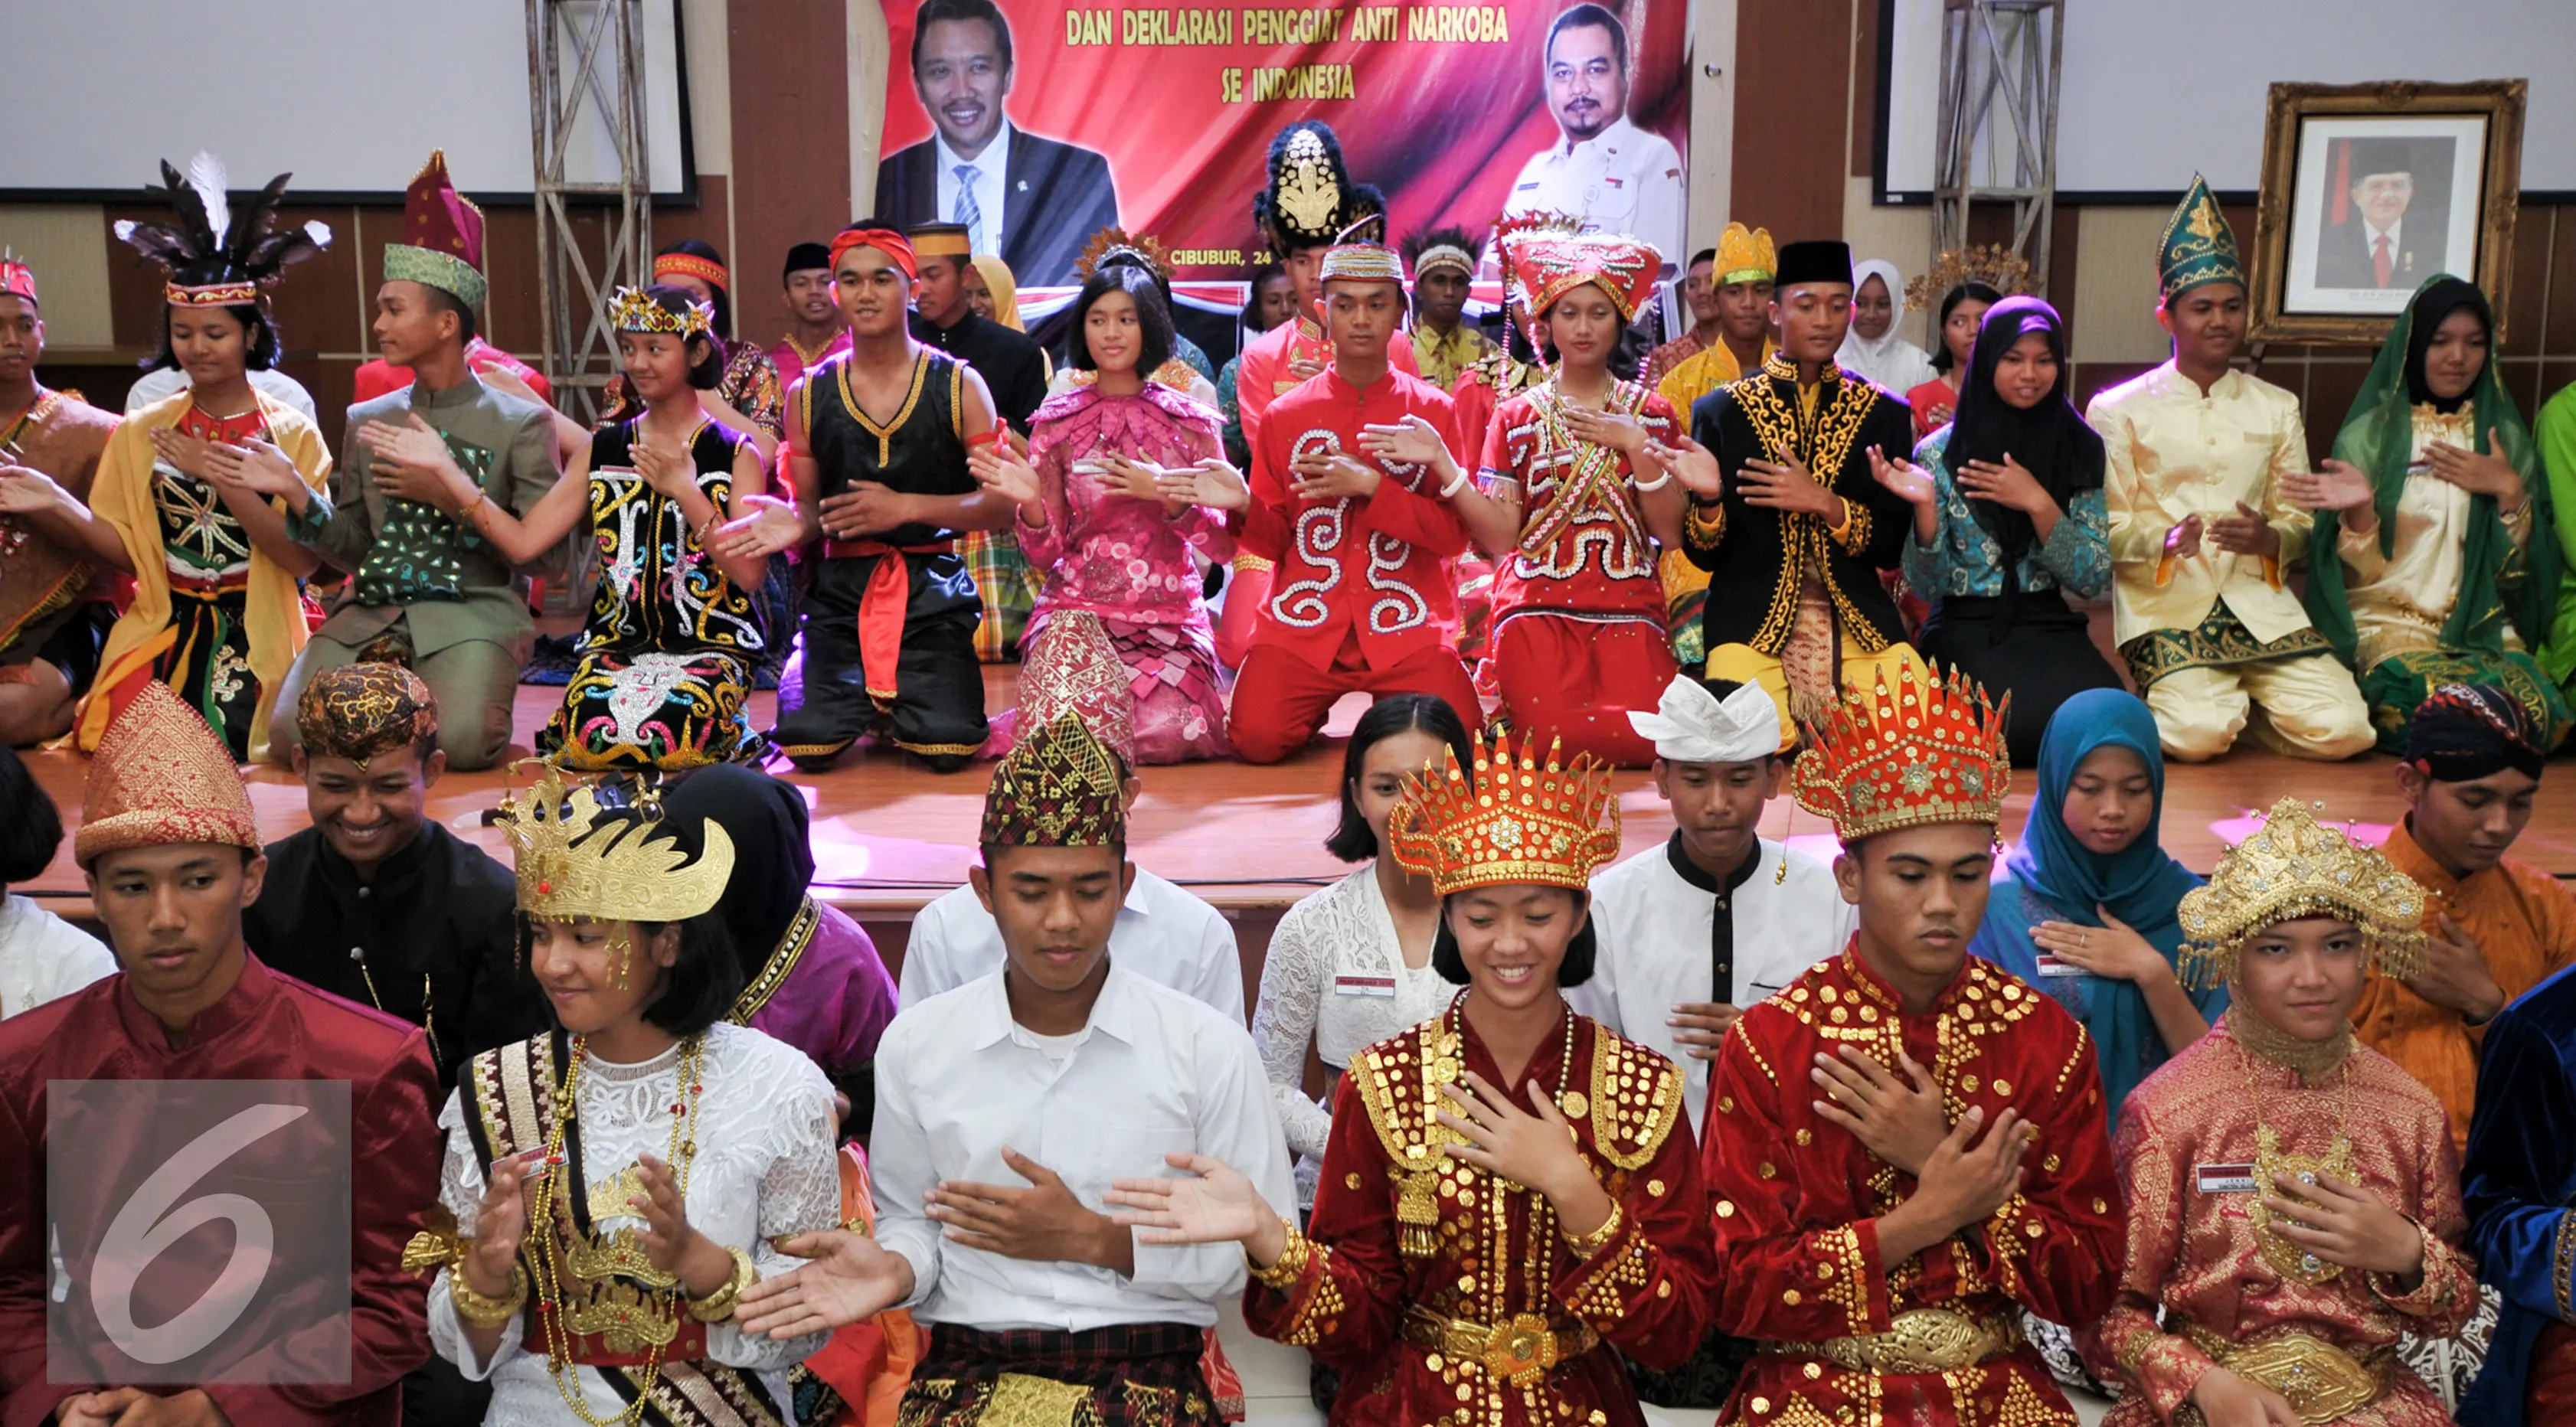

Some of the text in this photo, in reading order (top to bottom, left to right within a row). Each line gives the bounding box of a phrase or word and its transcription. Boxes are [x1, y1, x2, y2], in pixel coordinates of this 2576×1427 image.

[1067, 6, 1509, 45] DAN DEKLARASI PENGGIAT ANTI NARKOBA
[1221, 64, 1355, 103] SE INDONESIA
[1170, 249, 1272, 266] CIBUBUR, 24
